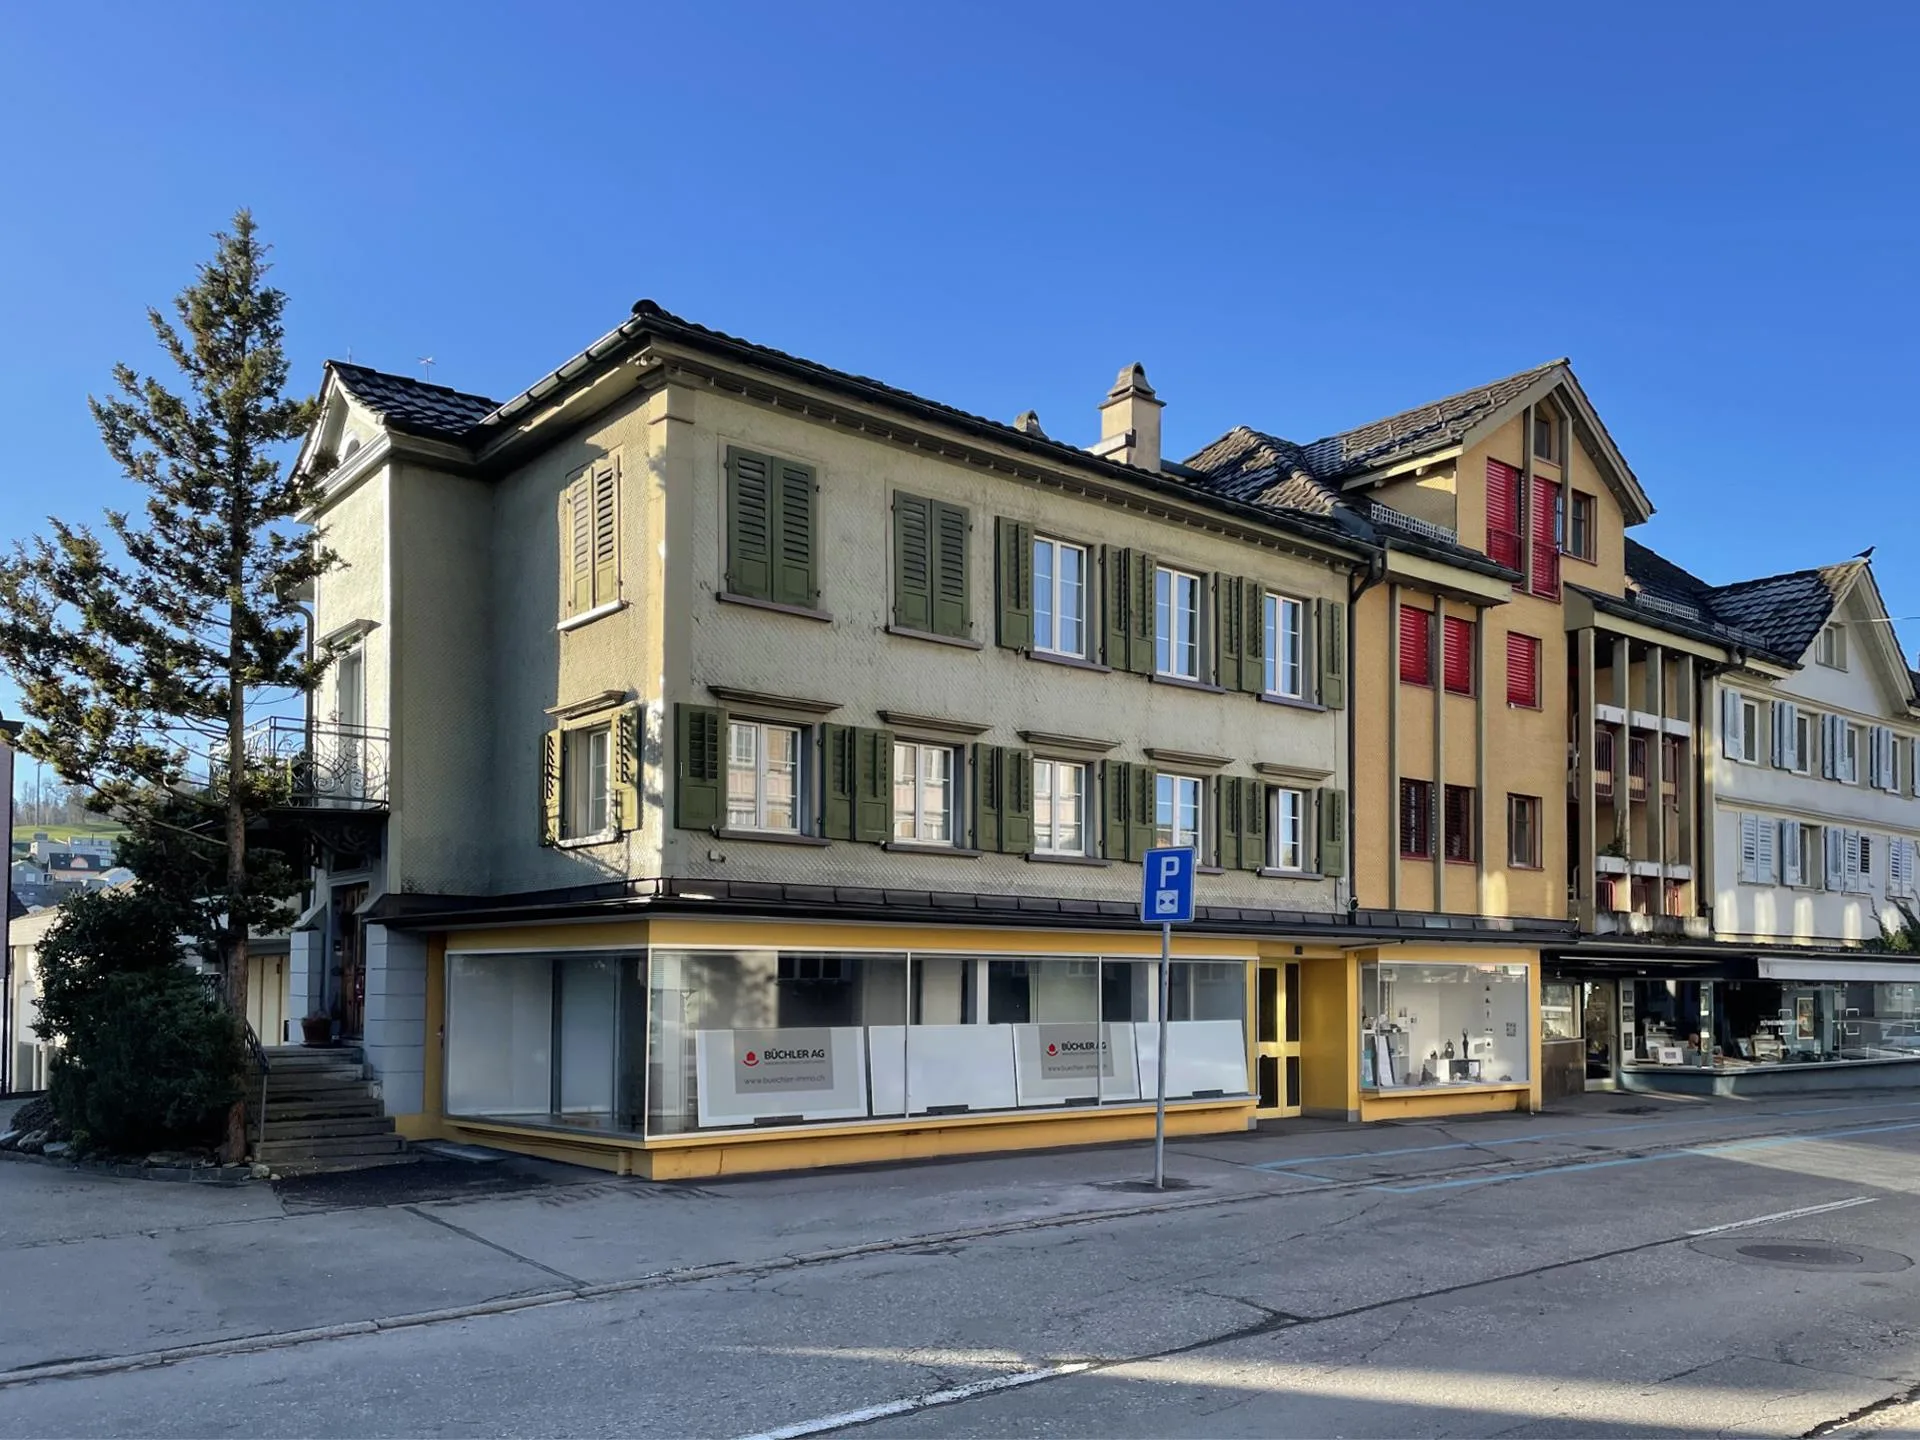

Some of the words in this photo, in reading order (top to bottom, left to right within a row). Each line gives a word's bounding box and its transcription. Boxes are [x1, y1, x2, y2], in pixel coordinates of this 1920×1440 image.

[1160, 856, 1179, 888] P
[1061, 1040, 1095, 1051] BÜCHLER
[764, 1048, 809, 1060] BÜCHLER
[811, 1049, 825, 1058] AG
